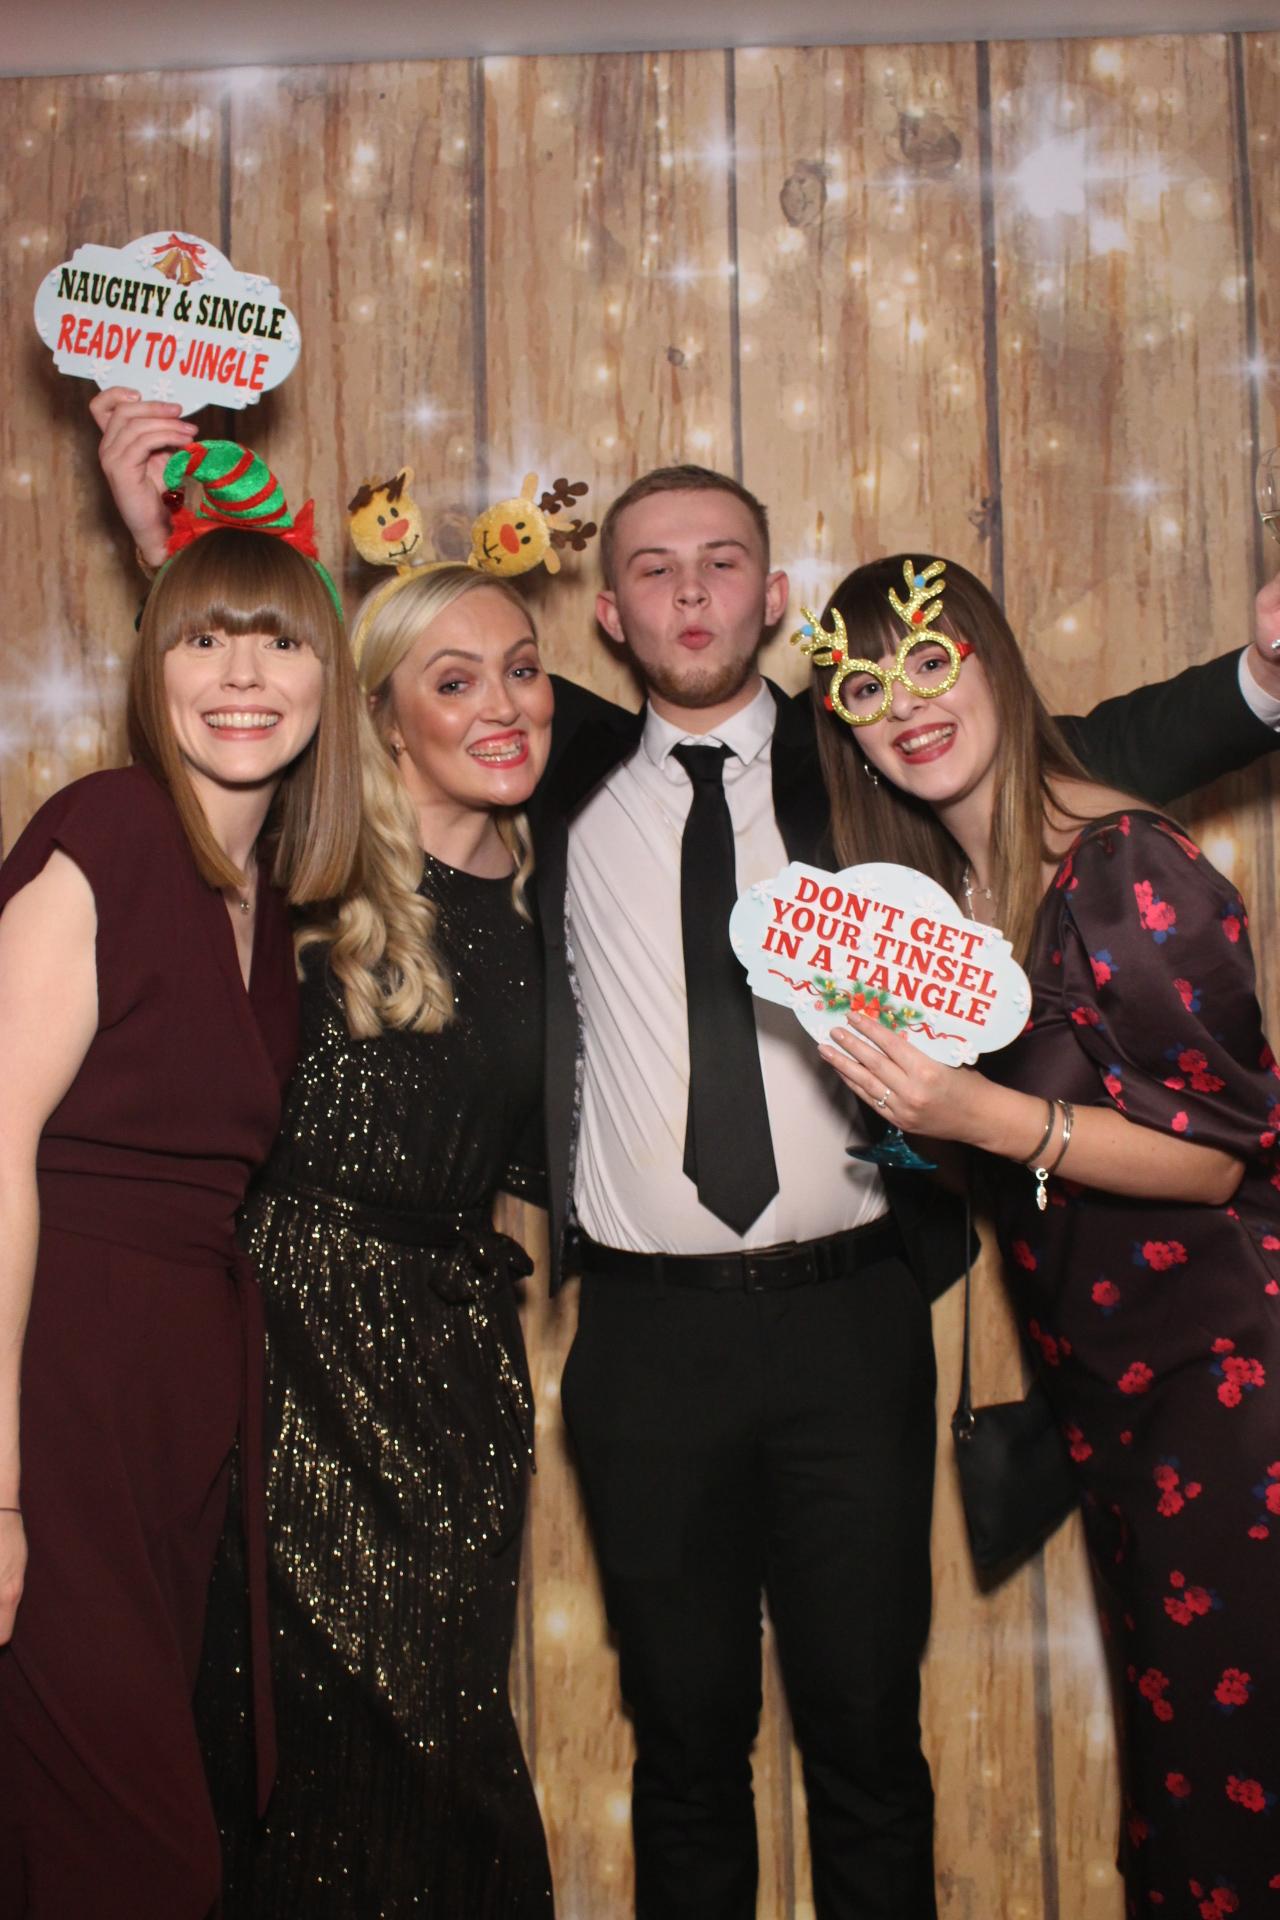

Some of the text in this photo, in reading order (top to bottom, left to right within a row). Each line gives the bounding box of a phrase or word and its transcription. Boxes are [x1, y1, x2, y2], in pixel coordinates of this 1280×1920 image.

[57, 267, 286, 340] NAUGHTY & SINGLE
[57, 313, 269, 390] READY TO JINGLE
[772, 898, 998, 999] YOUR TINSEL
[795, 876, 984, 959] DON'T GET
[761, 926, 992, 1027] IN A TANGLE
